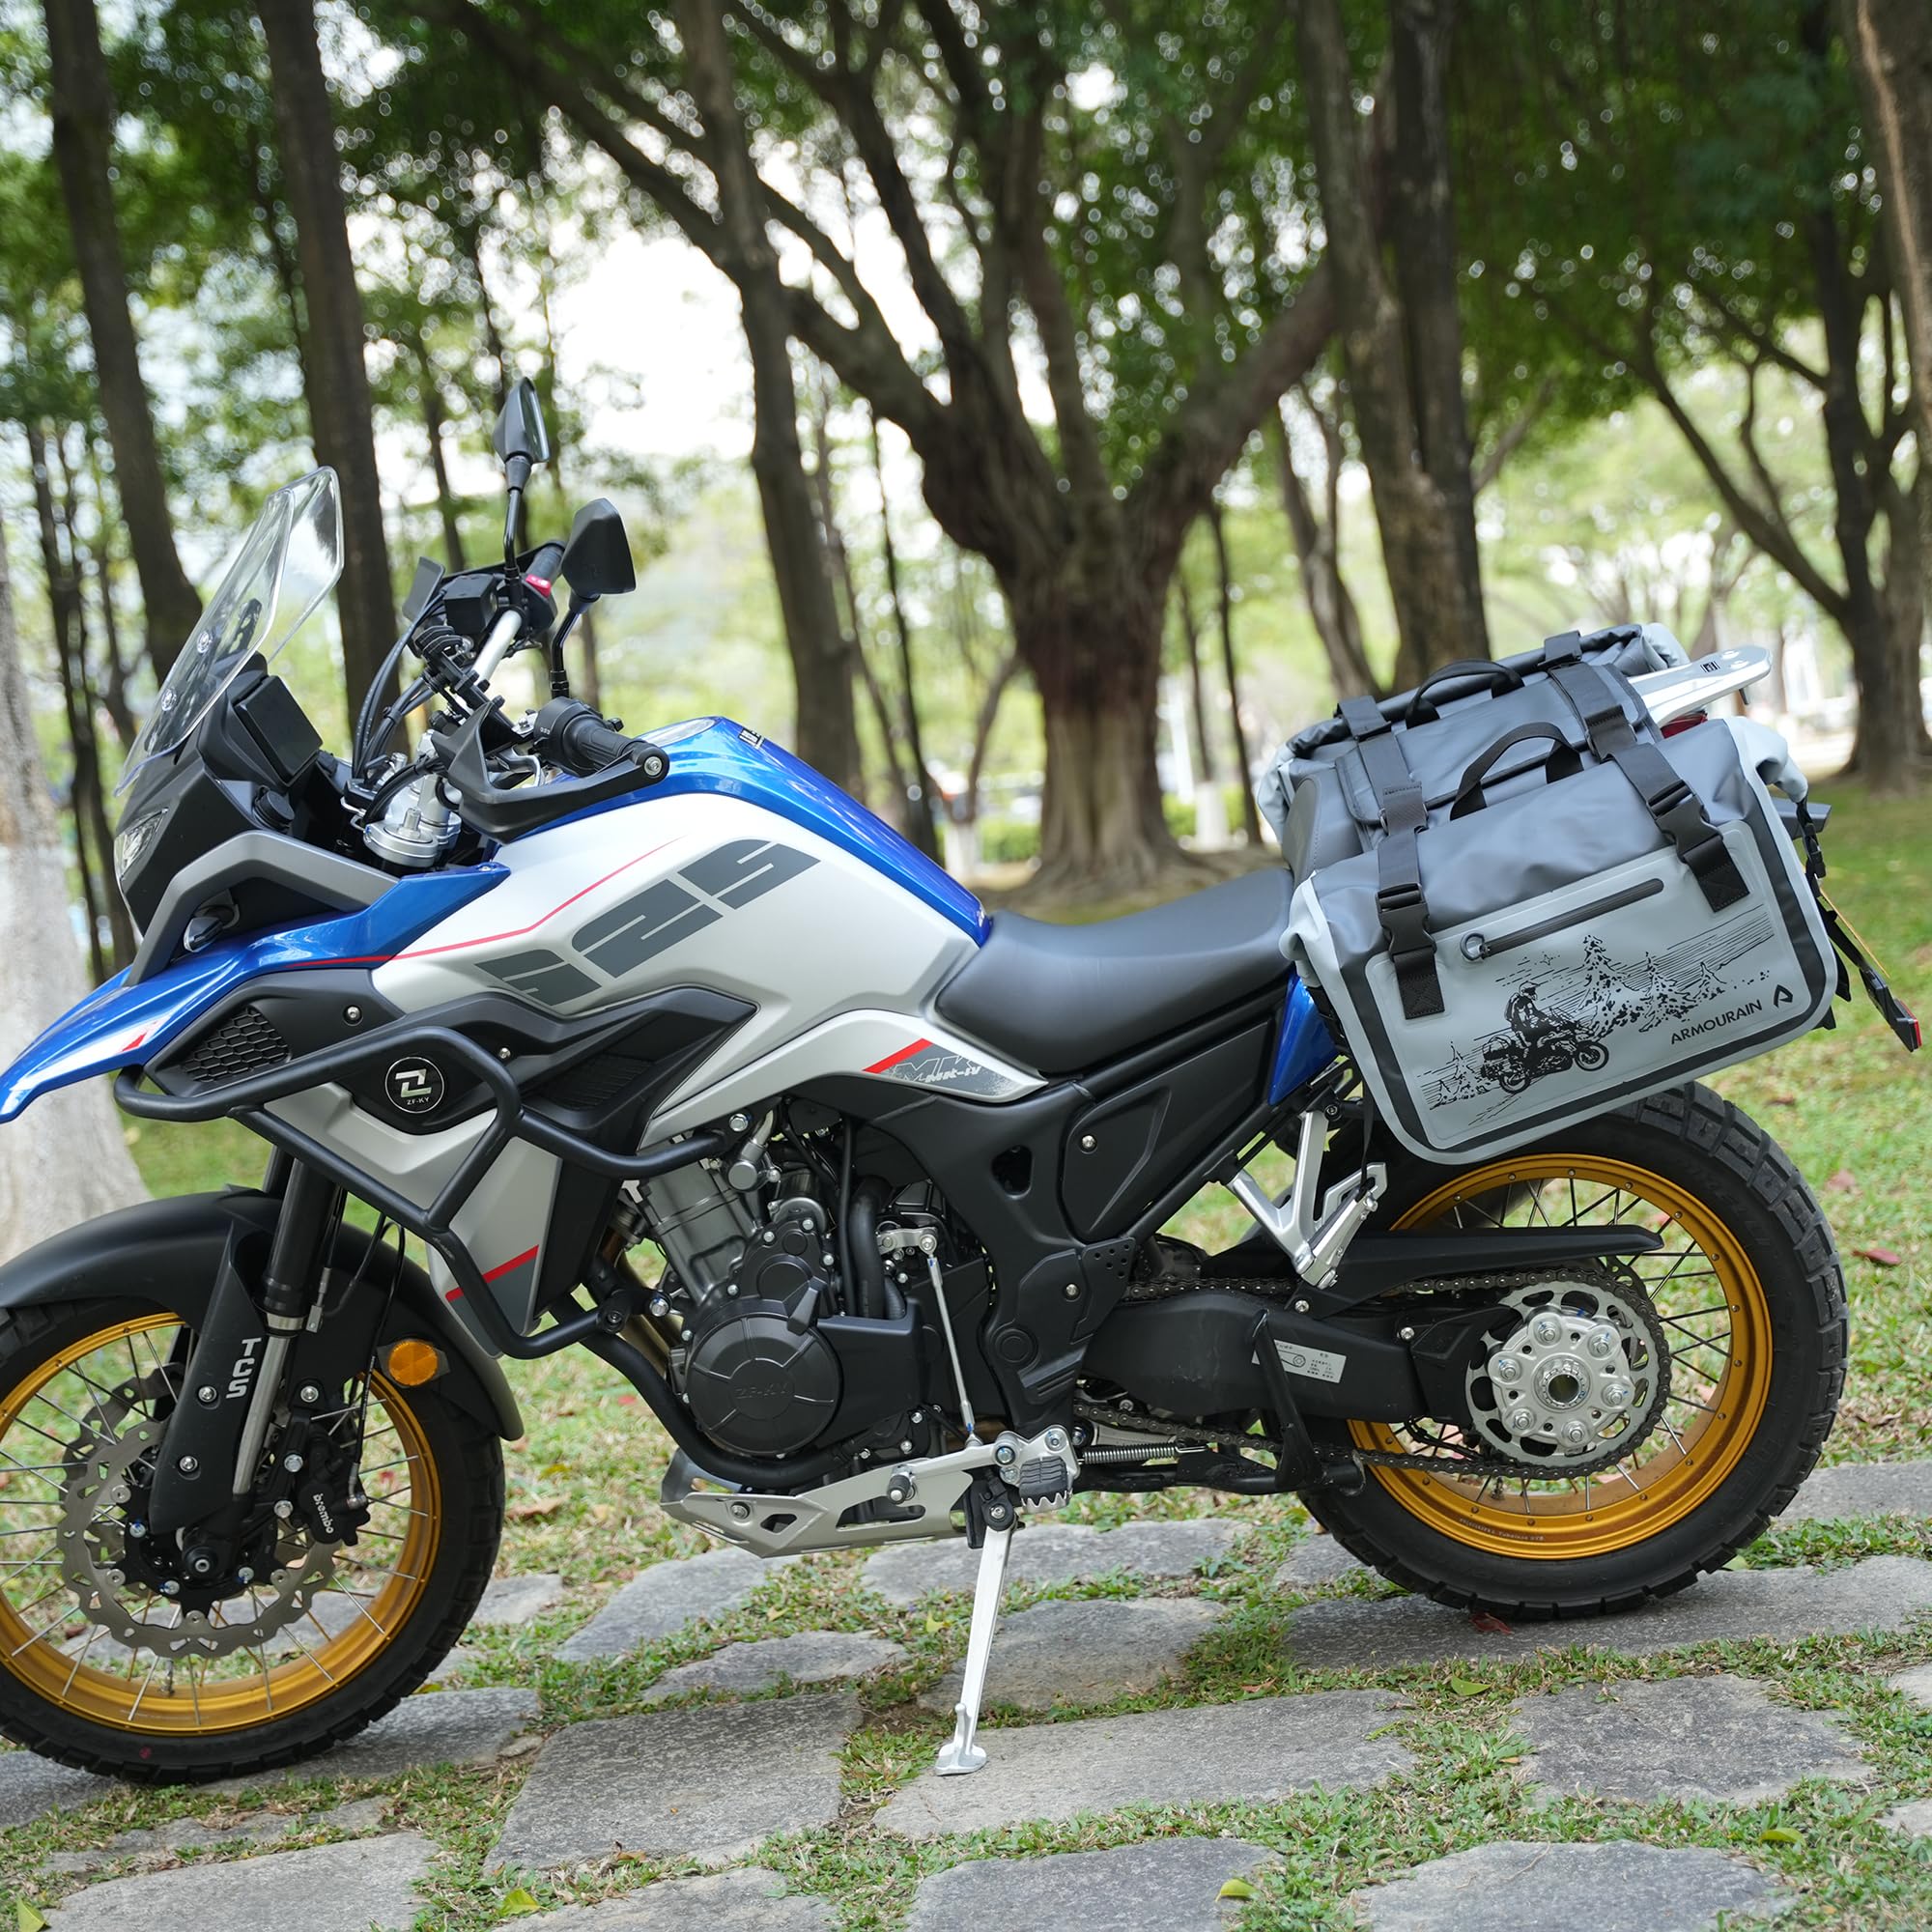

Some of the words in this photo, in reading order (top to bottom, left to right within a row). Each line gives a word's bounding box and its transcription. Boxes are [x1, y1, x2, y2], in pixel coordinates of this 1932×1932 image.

[1670, 999, 1763, 1045] ARMOURAIN
[407, 1096, 431, 1106] ZF-KY
[225, 1337, 263, 1400] TCS
[312, 1492, 335, 1534] brembo
